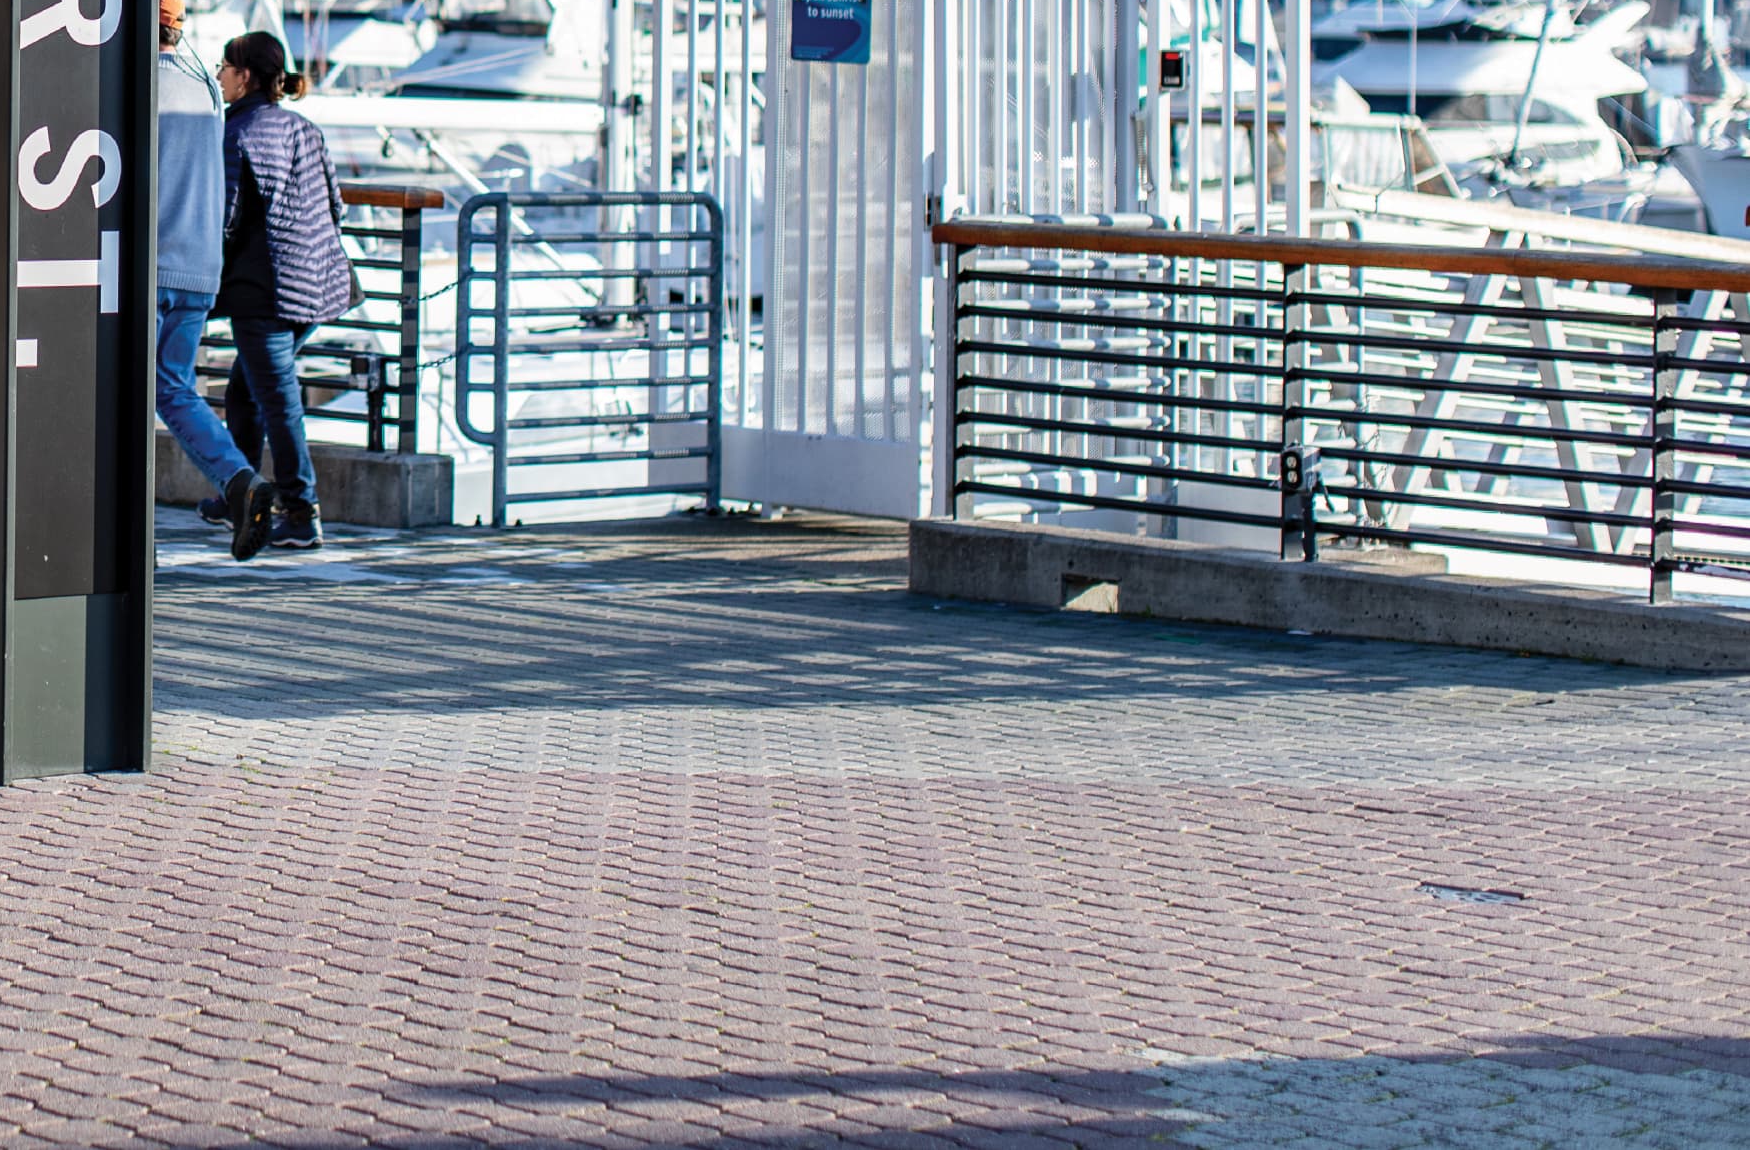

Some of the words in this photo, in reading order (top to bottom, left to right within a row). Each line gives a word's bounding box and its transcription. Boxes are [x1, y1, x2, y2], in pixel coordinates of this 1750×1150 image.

[808, 7, 818, 17] to
[821, 7, 854, 19] sunset
[16, 126, 122, 368] ST.
